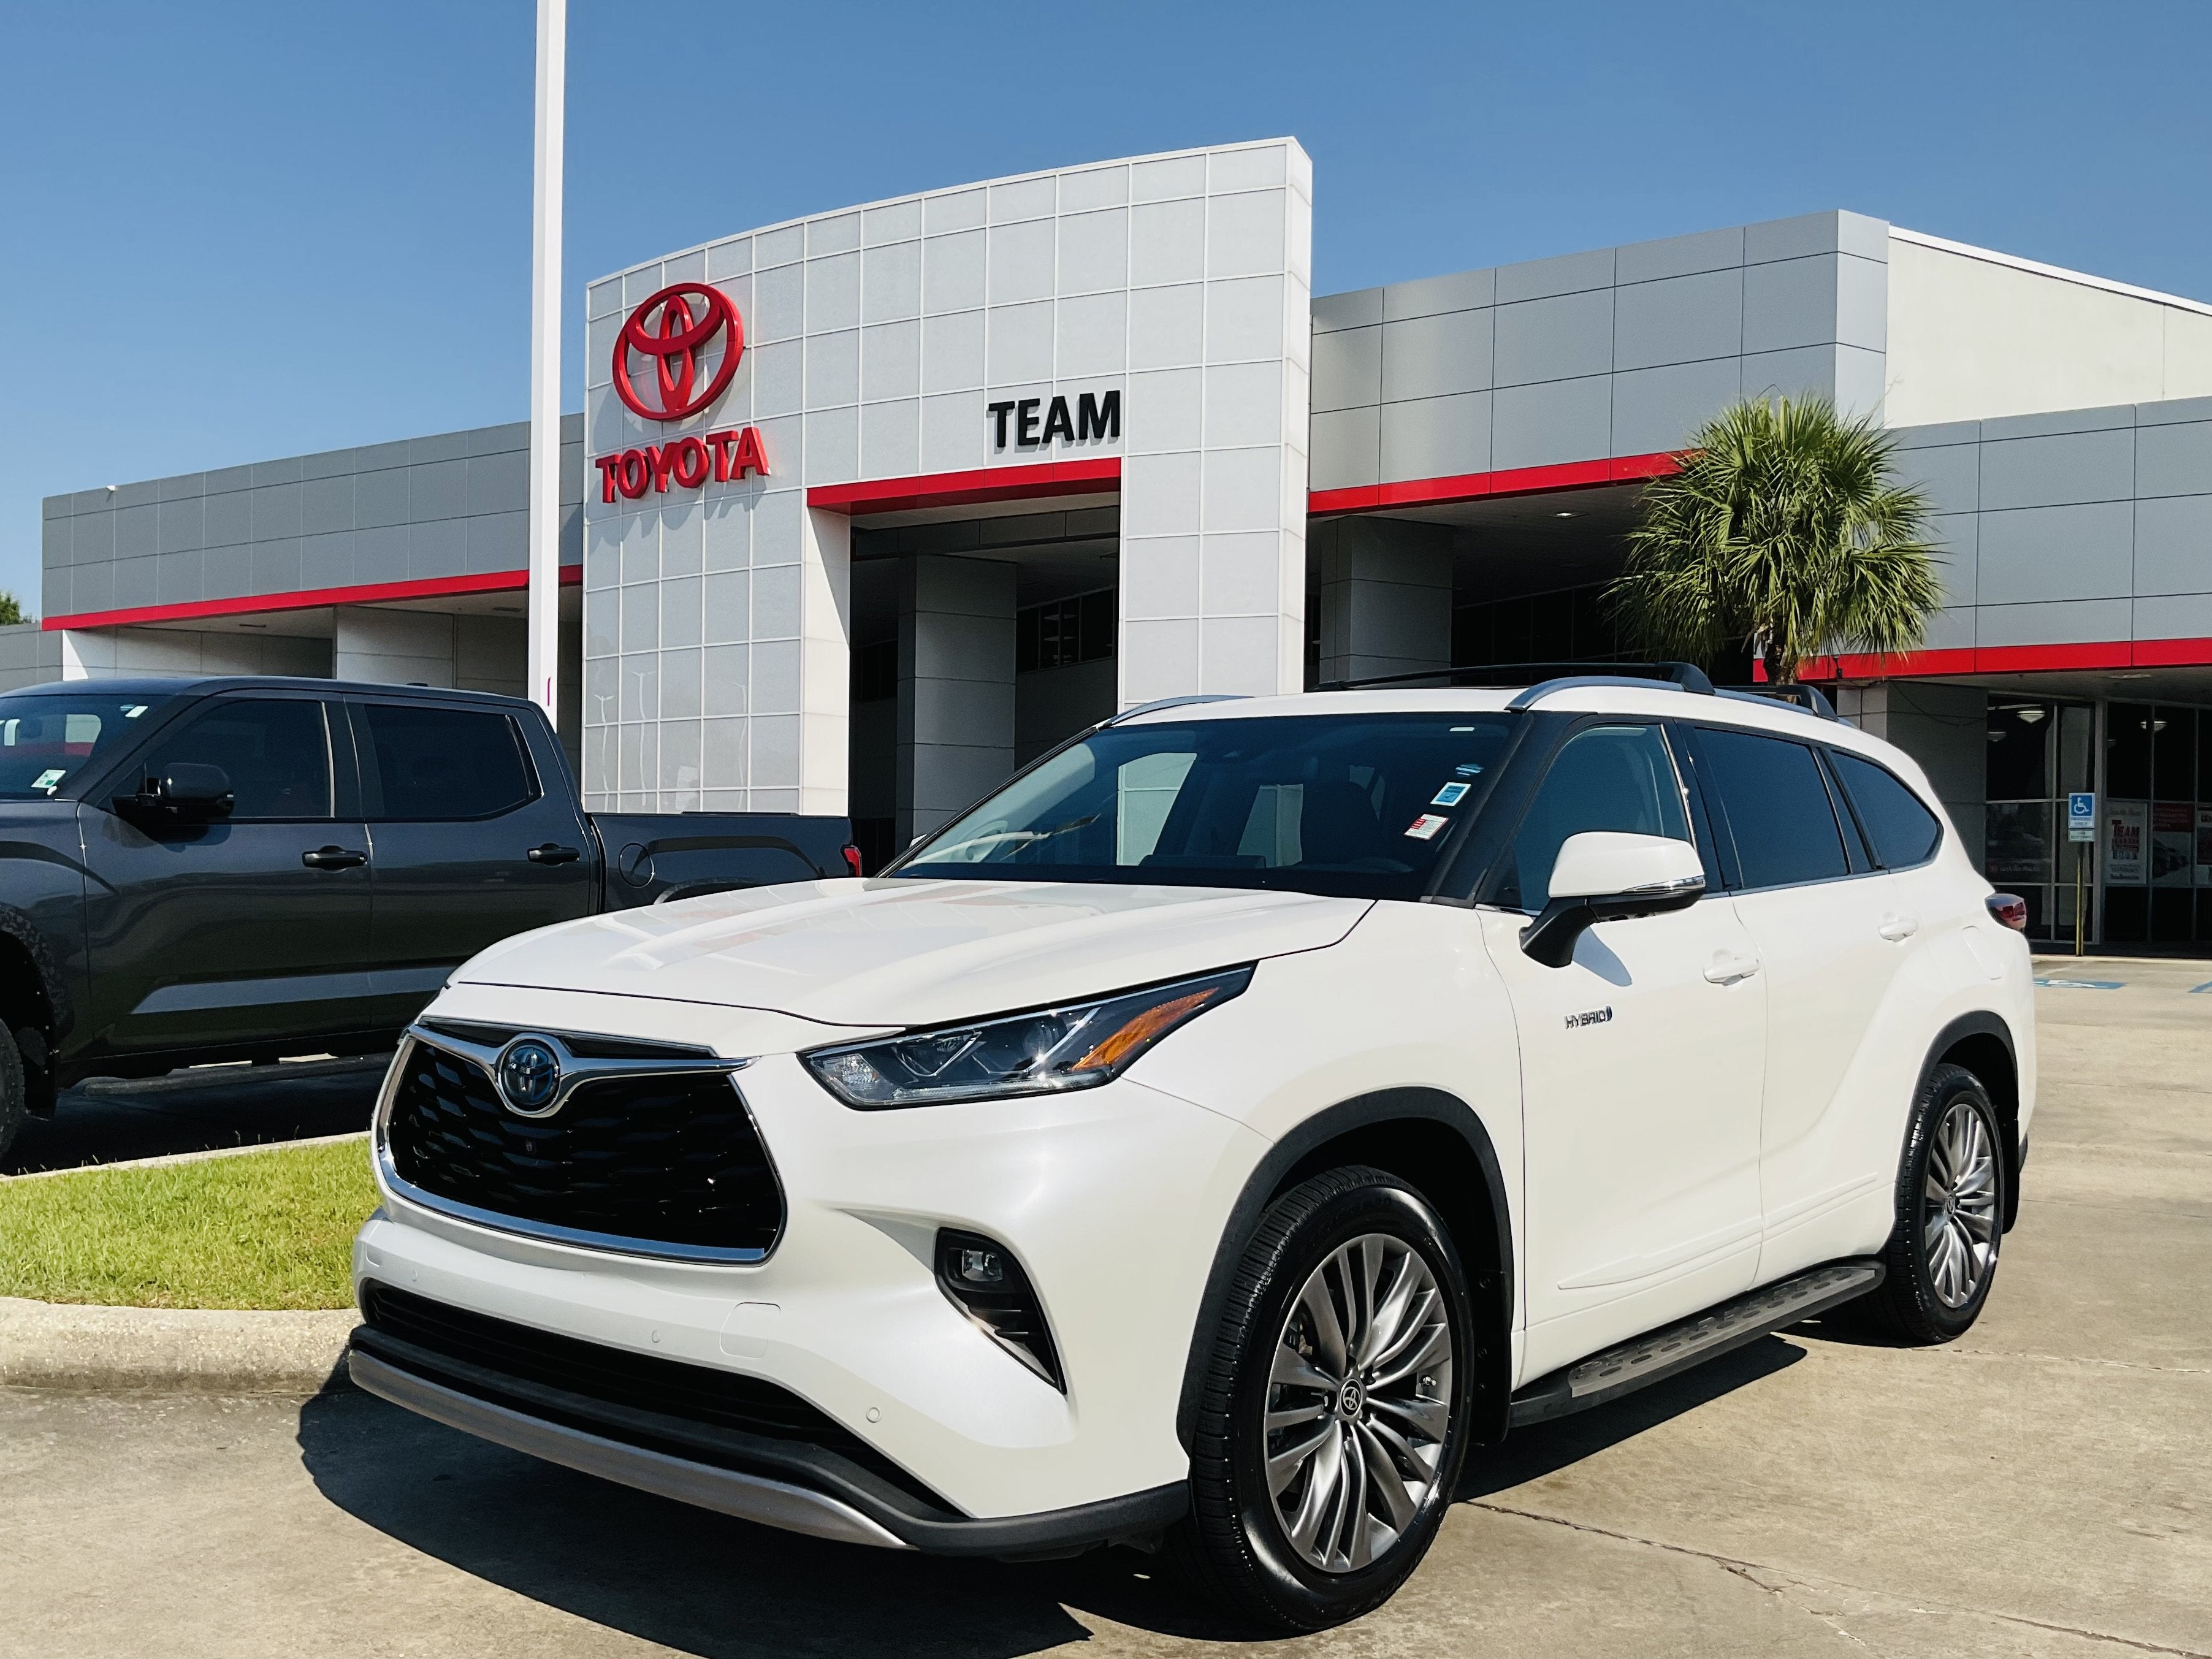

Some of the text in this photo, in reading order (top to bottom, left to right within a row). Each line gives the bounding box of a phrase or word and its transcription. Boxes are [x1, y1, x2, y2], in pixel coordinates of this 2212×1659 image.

[988, 390, 1121, 448] TEAM
[595, 427, 770, 503] TOYOTA
[1564, 1009, 1606, 1029] HYBRID
